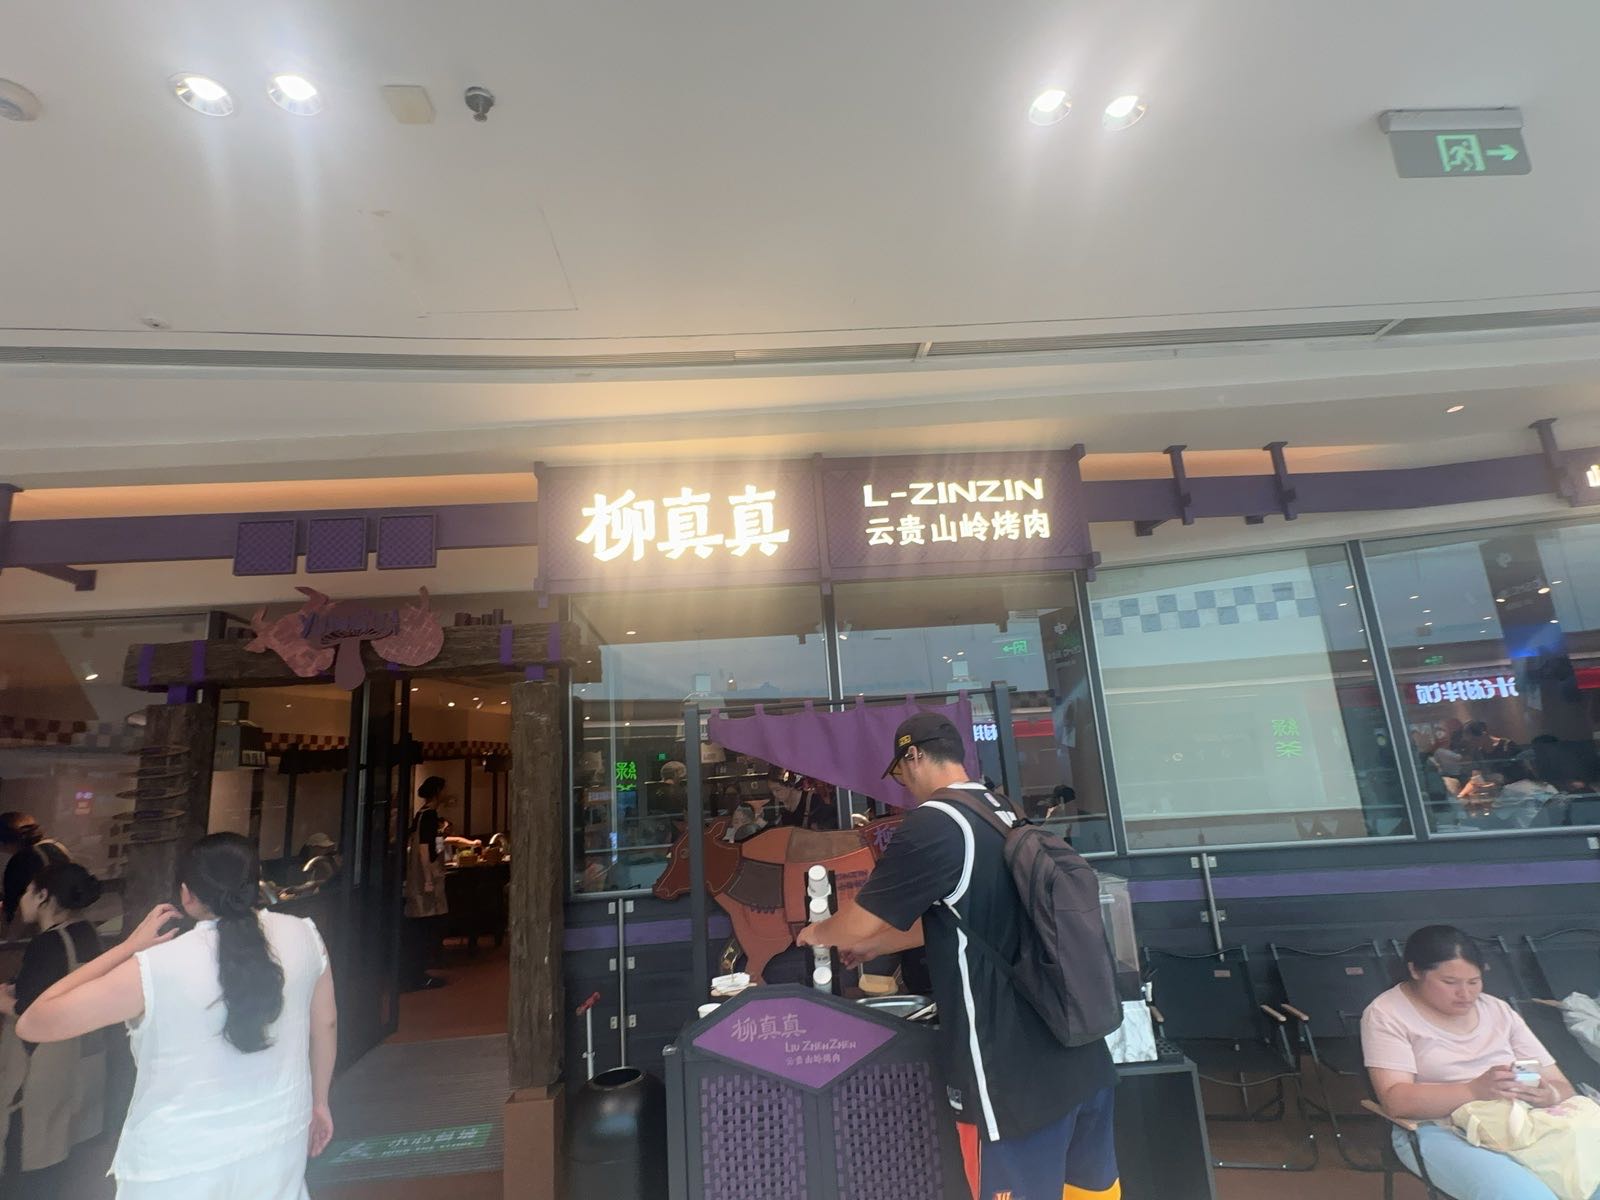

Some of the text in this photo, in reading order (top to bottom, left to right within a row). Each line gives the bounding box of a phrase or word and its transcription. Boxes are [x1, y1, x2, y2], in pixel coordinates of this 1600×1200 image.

[863, 478, 1044, 507] L-ZINZIN
[576, 484, 790, 562] 柳真真
[865, 508, 1050, 546] 云贵山岭烤肉
[731, 1013, 807, 1042] 柳真真
